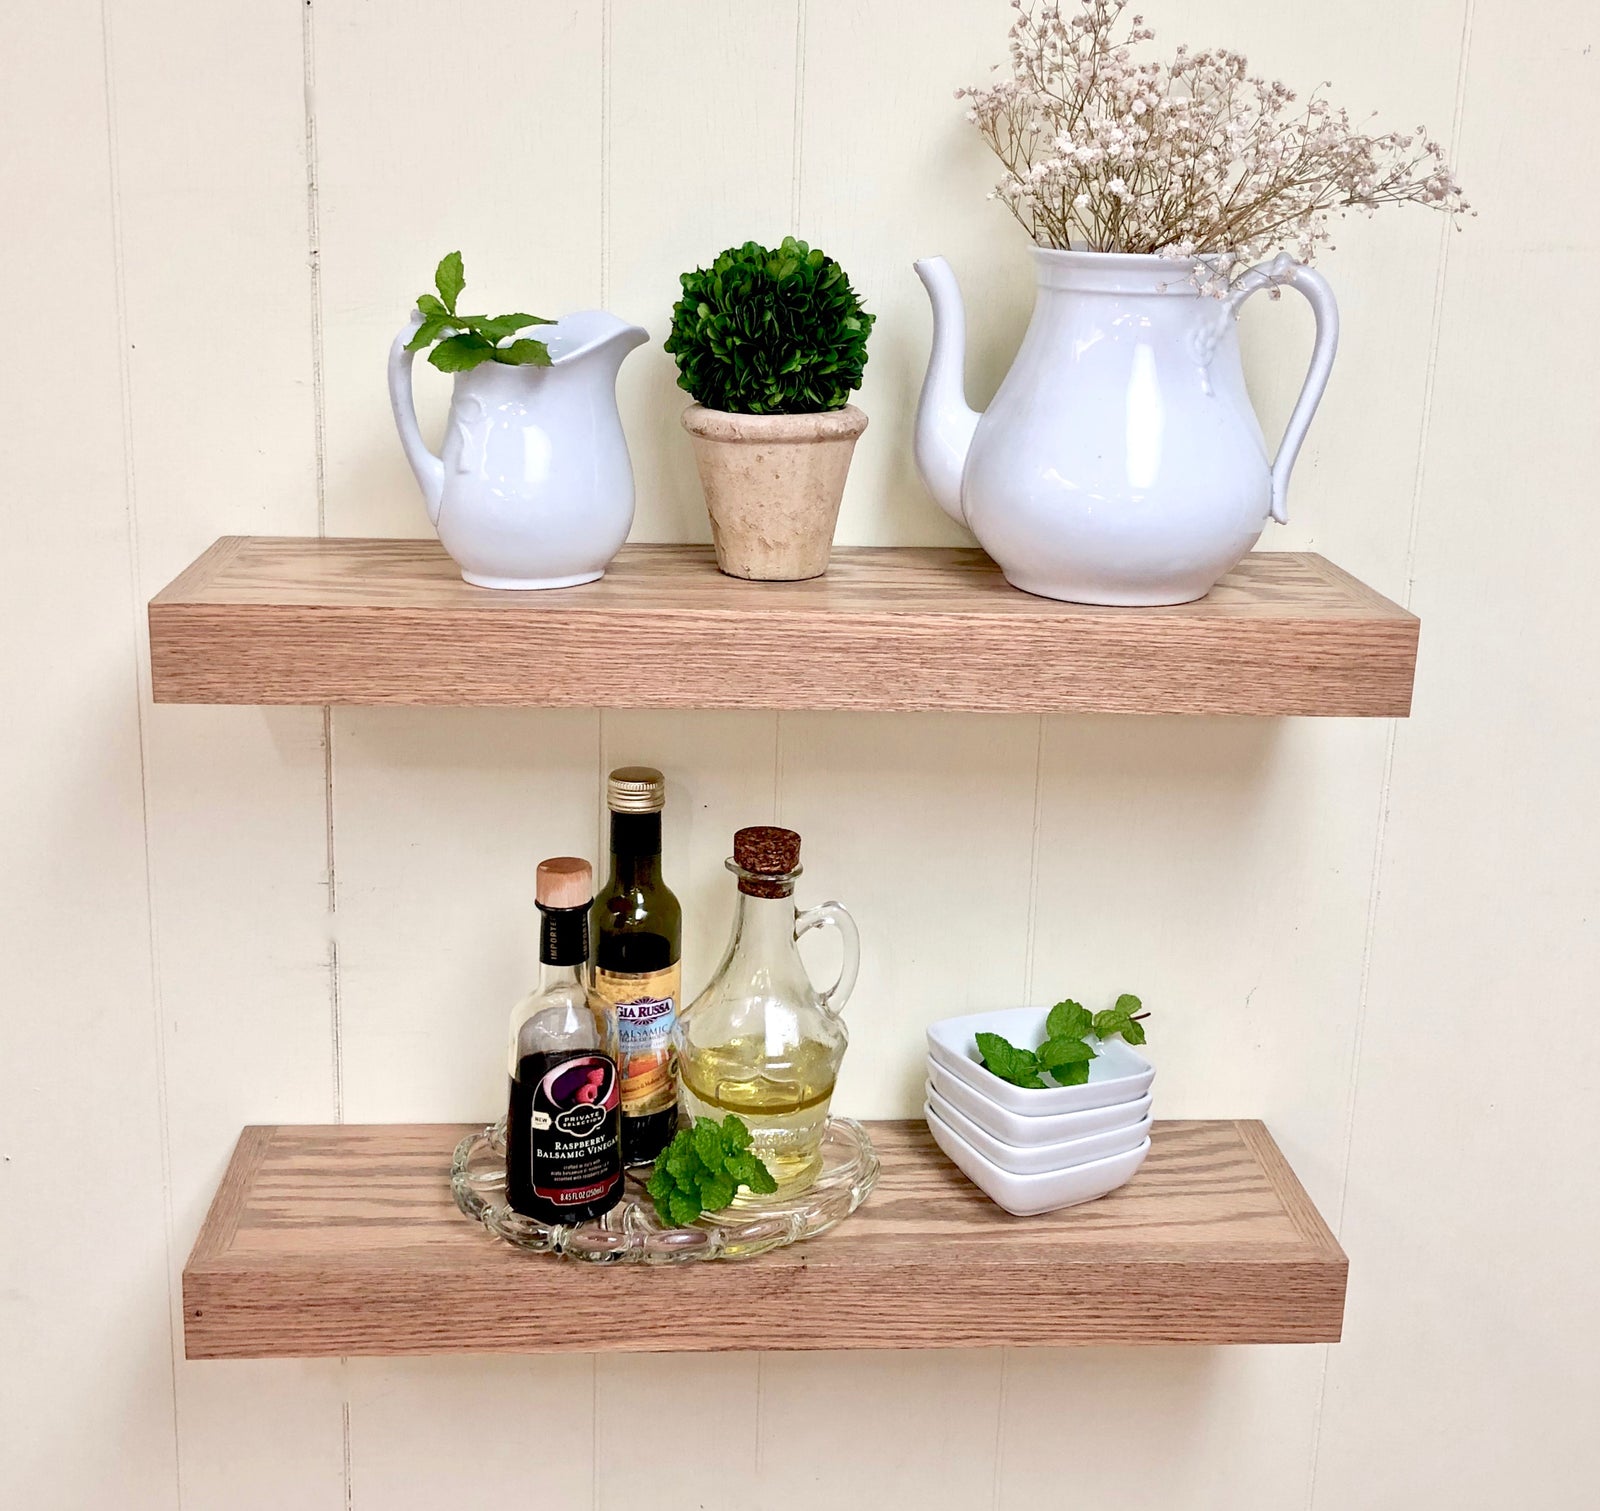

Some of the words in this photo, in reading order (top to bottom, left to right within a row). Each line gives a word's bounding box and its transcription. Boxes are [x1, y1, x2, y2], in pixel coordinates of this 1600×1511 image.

[617, 1005, 636, 1018] GIA
[638, 1002, 670, 1018] RUSSA
[562, 1116, 602, 1127] SELECTION
[564, 1111, 600, 1122] PRIVATE
[554, 1134, 606, 1151] RASPBERRY
[536, 1148, 585, 1159] BALSAMIC
[560, 1193, 572, 1202] 8.45
[572, 1192, 578, 1200] FL
[579, 1191, 586, 1199] OZ
